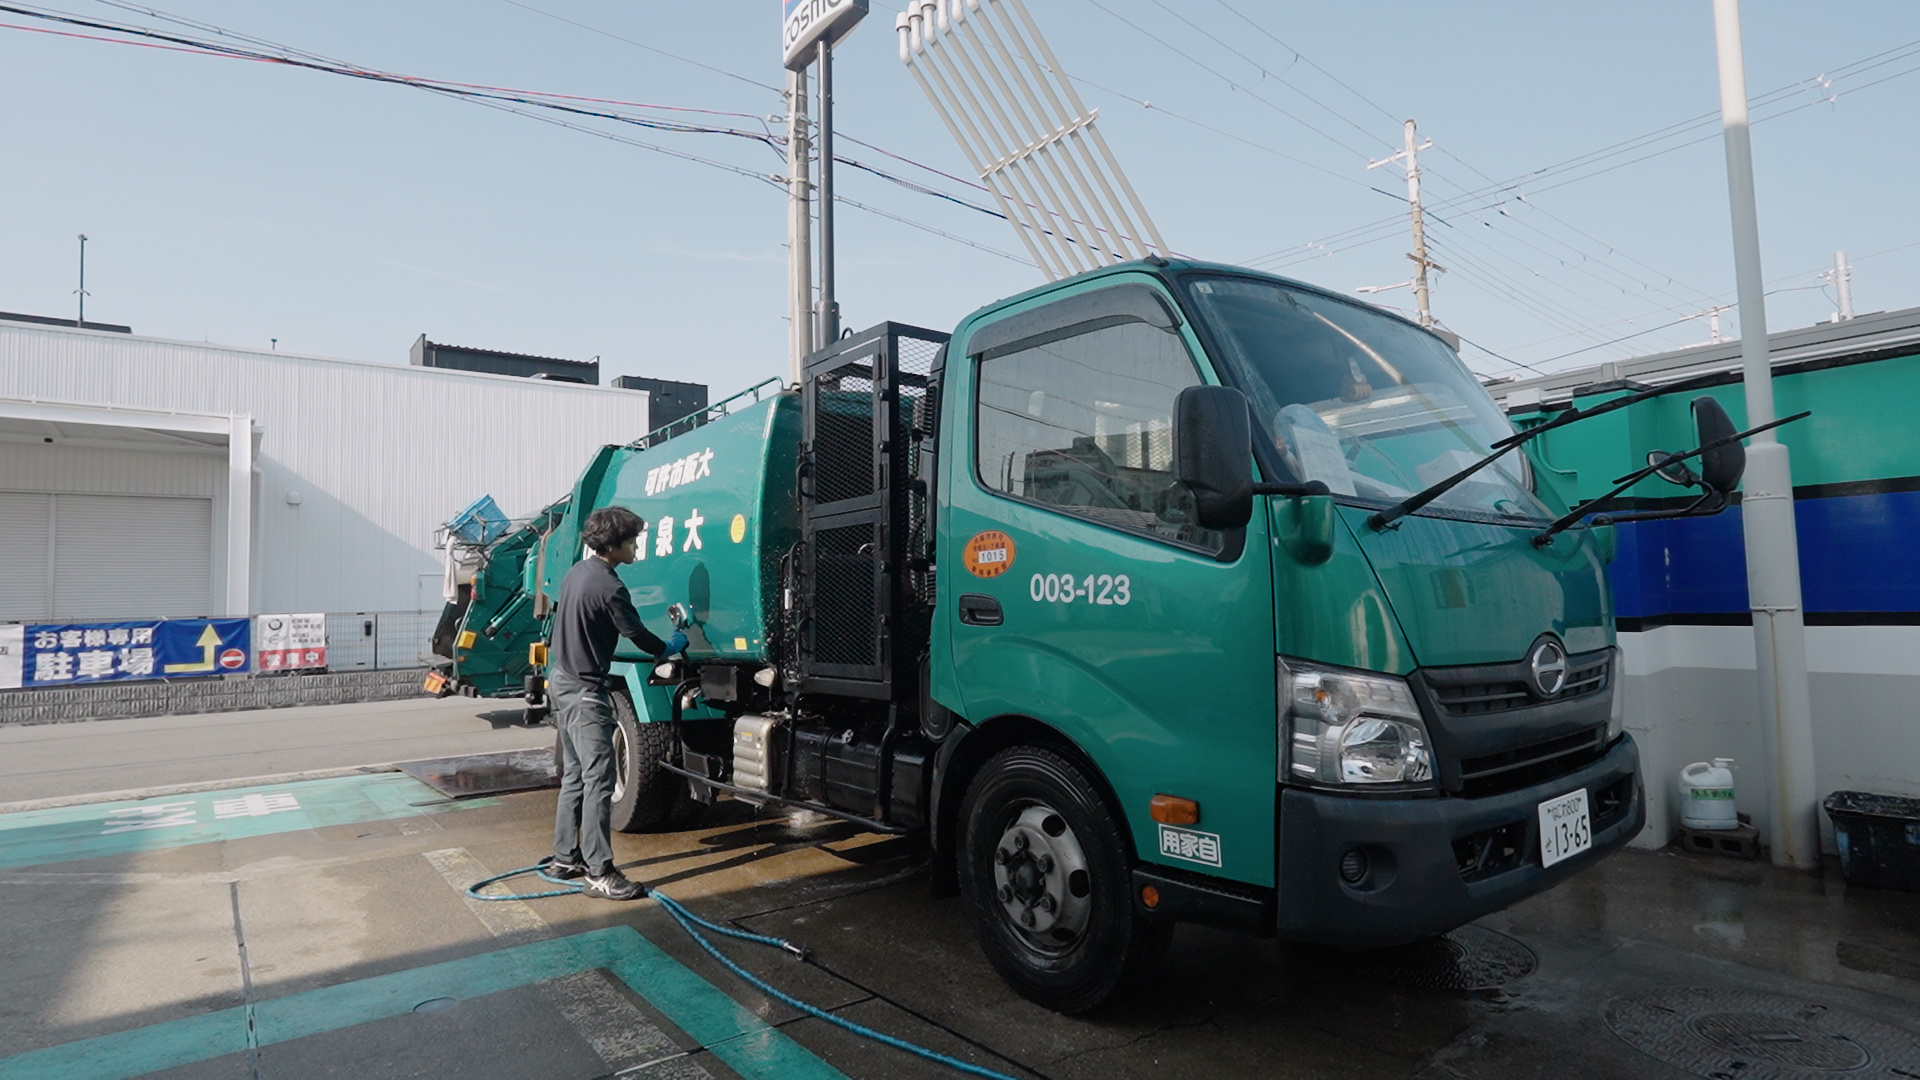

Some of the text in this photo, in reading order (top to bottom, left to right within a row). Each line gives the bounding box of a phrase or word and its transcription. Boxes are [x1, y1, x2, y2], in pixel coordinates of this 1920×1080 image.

[785, 0, 841, 51] COSM
[982, 550, 1004, 562] 1015
[1030, 573, 1131, 605] 003-123
[34, 628, 153, 649] お客様専用
[34, 647, 154, 681] 駐車場
[1555, 814, 1589, 856] 13-65
